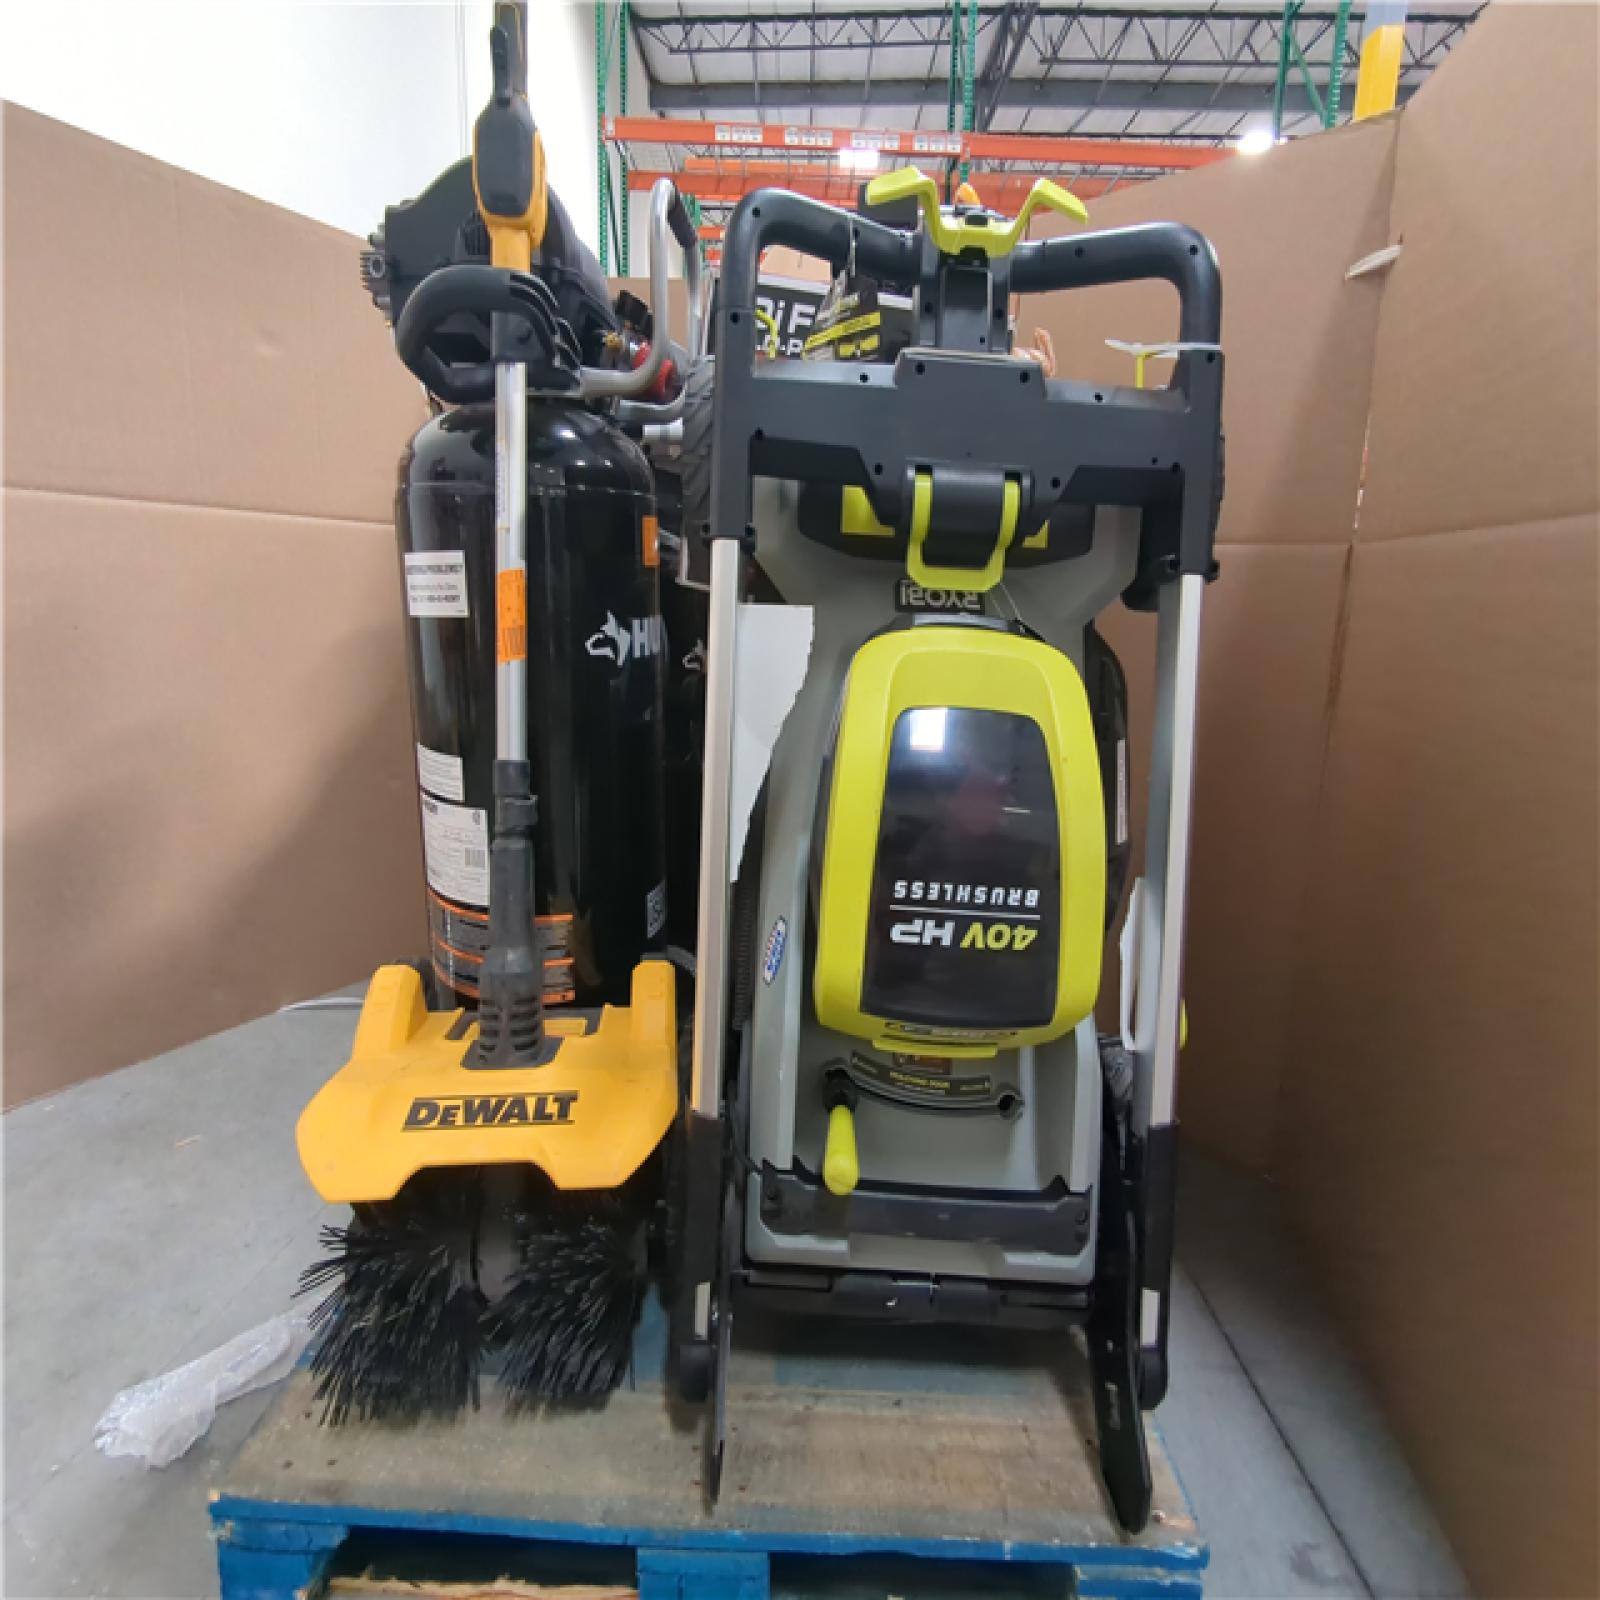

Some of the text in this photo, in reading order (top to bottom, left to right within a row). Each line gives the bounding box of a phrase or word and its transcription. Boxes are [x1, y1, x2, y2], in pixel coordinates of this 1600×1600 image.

[894, 879, 1041, 908] BRUSHLESS
[890, 918, 1039, 951] 40V HP
